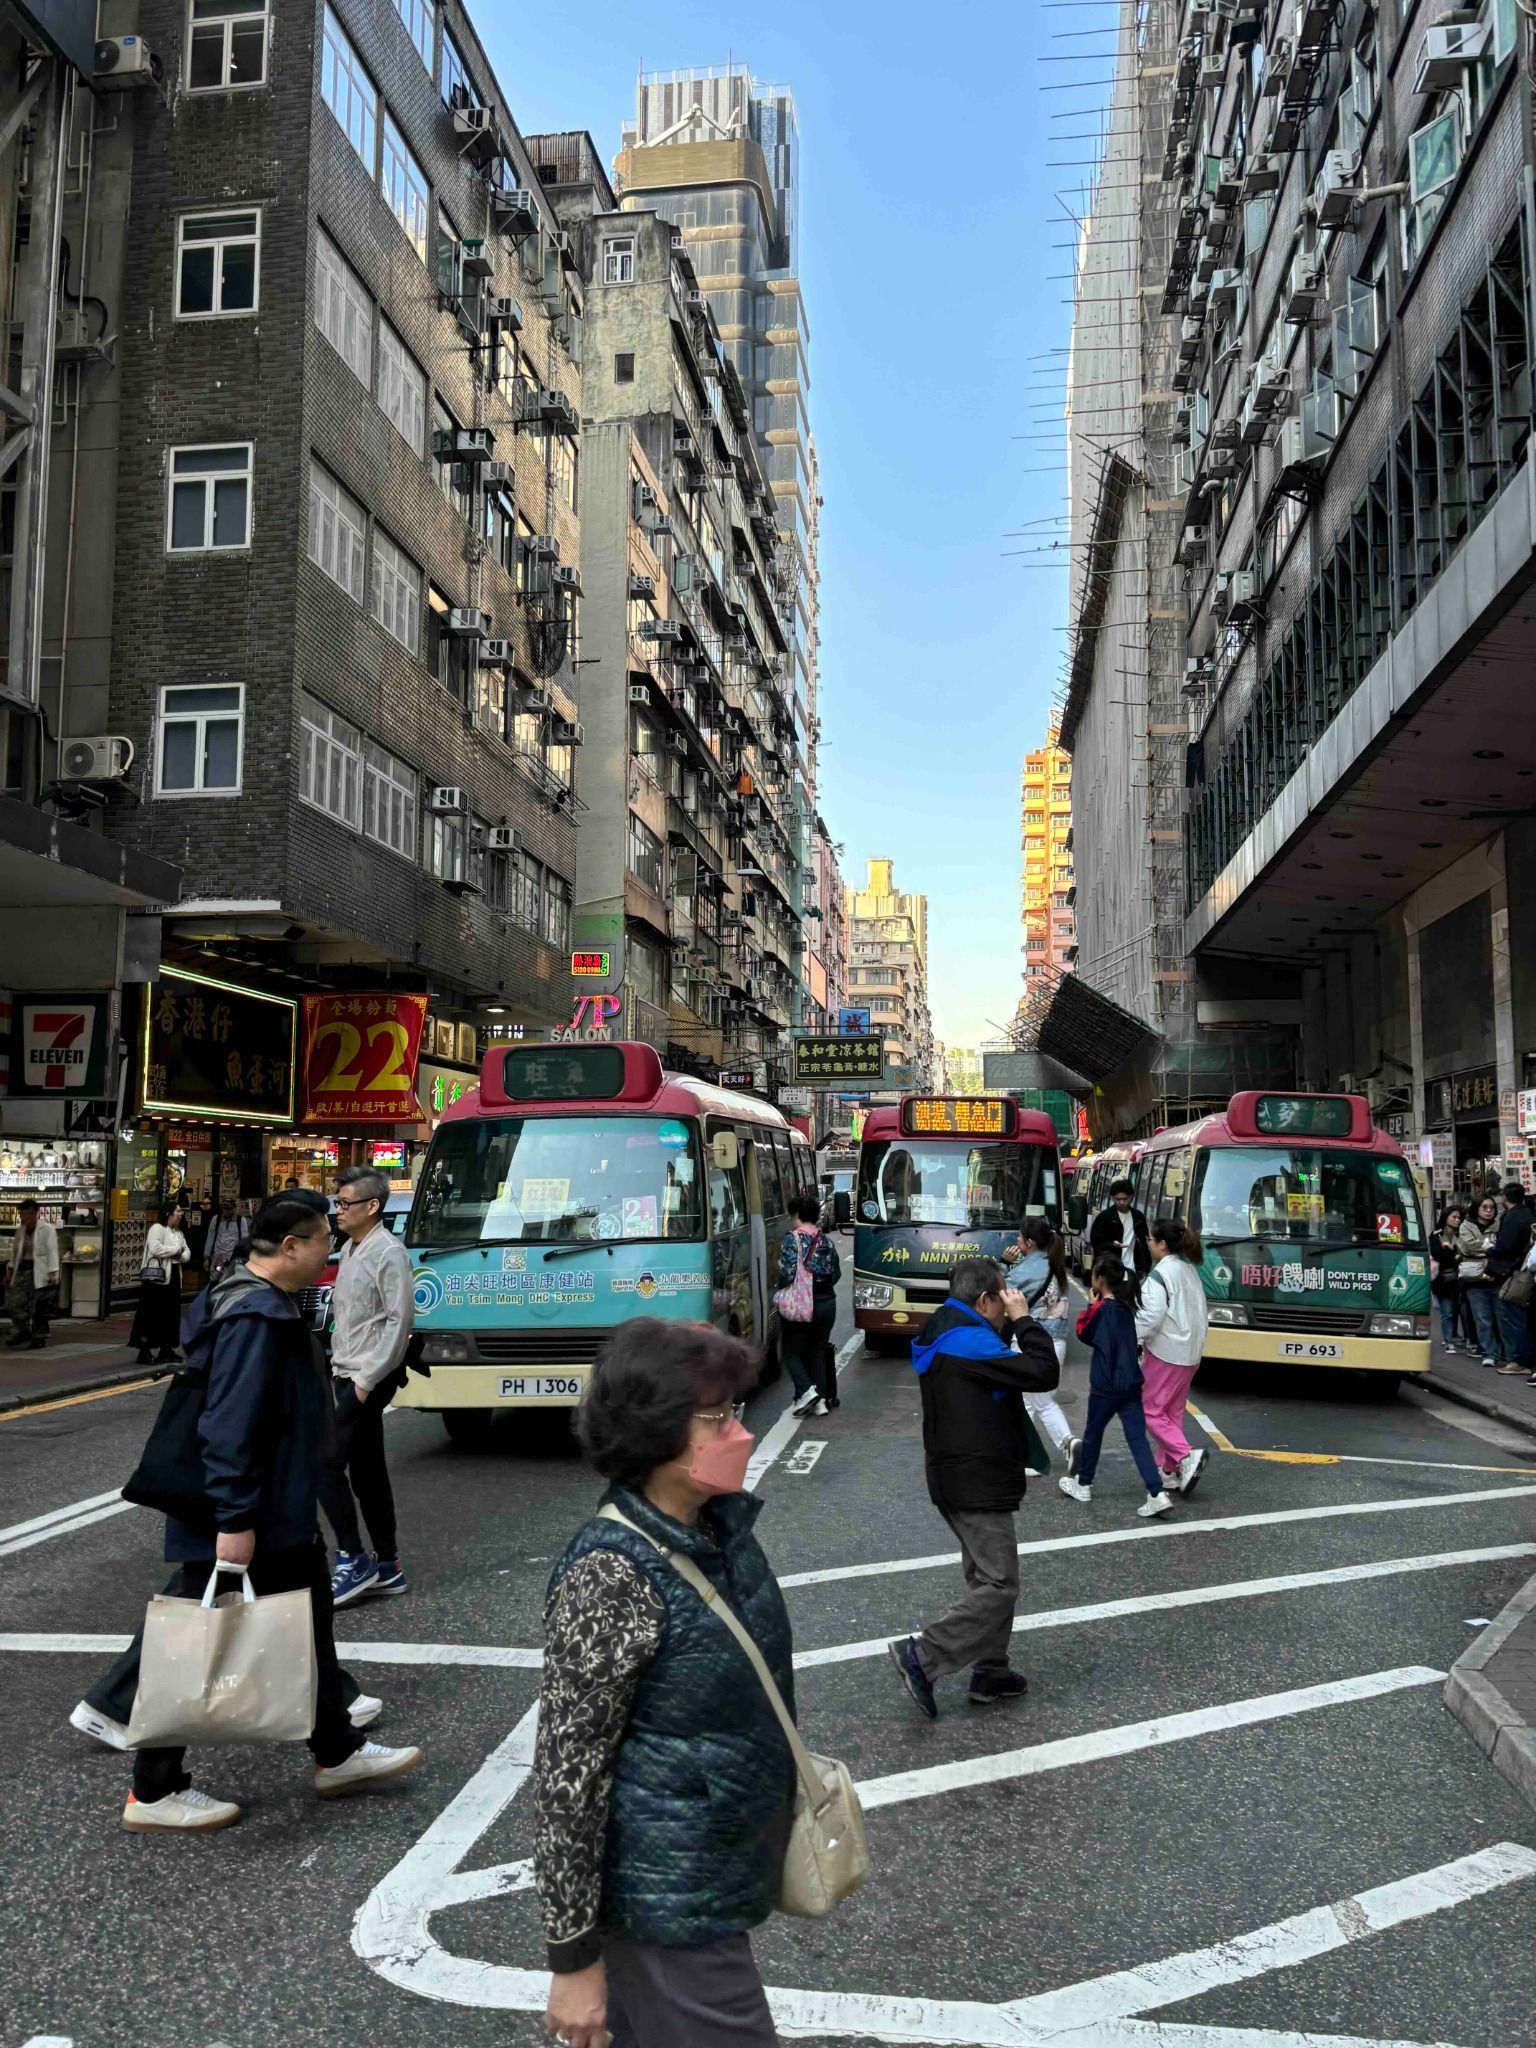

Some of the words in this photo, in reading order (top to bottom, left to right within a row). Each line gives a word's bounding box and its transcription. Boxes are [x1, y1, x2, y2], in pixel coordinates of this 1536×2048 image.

[155, 989, 233, 1043] 香港仔
[550, 1028, 612, 1042] SALON
[33, 1013, 86, 1088] 7
[312, 1021, 411, 1092] 22
[919, 1252, 950, 1263] NMN
[445, 1272, 594, 1291] 油尖旺地區康健站
[1241, 1263, 1325, 1291] 唔好餵喇
[1327, 1270, 1356, 1281] DON'T
[1357, 1272, 1380, 1282] FEED
[1328, 1280, 1351, 1290] WILD
[1352, 1281, 1373, 1291] PIGS
[446, 1295, 463, 1305] Yau
[468, 1294, 491, 1305] Tsim
[497, 1294, 523, 1305] Mong
[529, 1293, 550, 1304] DHC
[555, 1292, 594, 1303] Express
[1285, 1343, 1303, 1355] FP
[1309, 1344, 1336, 1356] 693
[502, 1379, 525, 1394] PH
[536, 1378, 578, 1394] 1306
